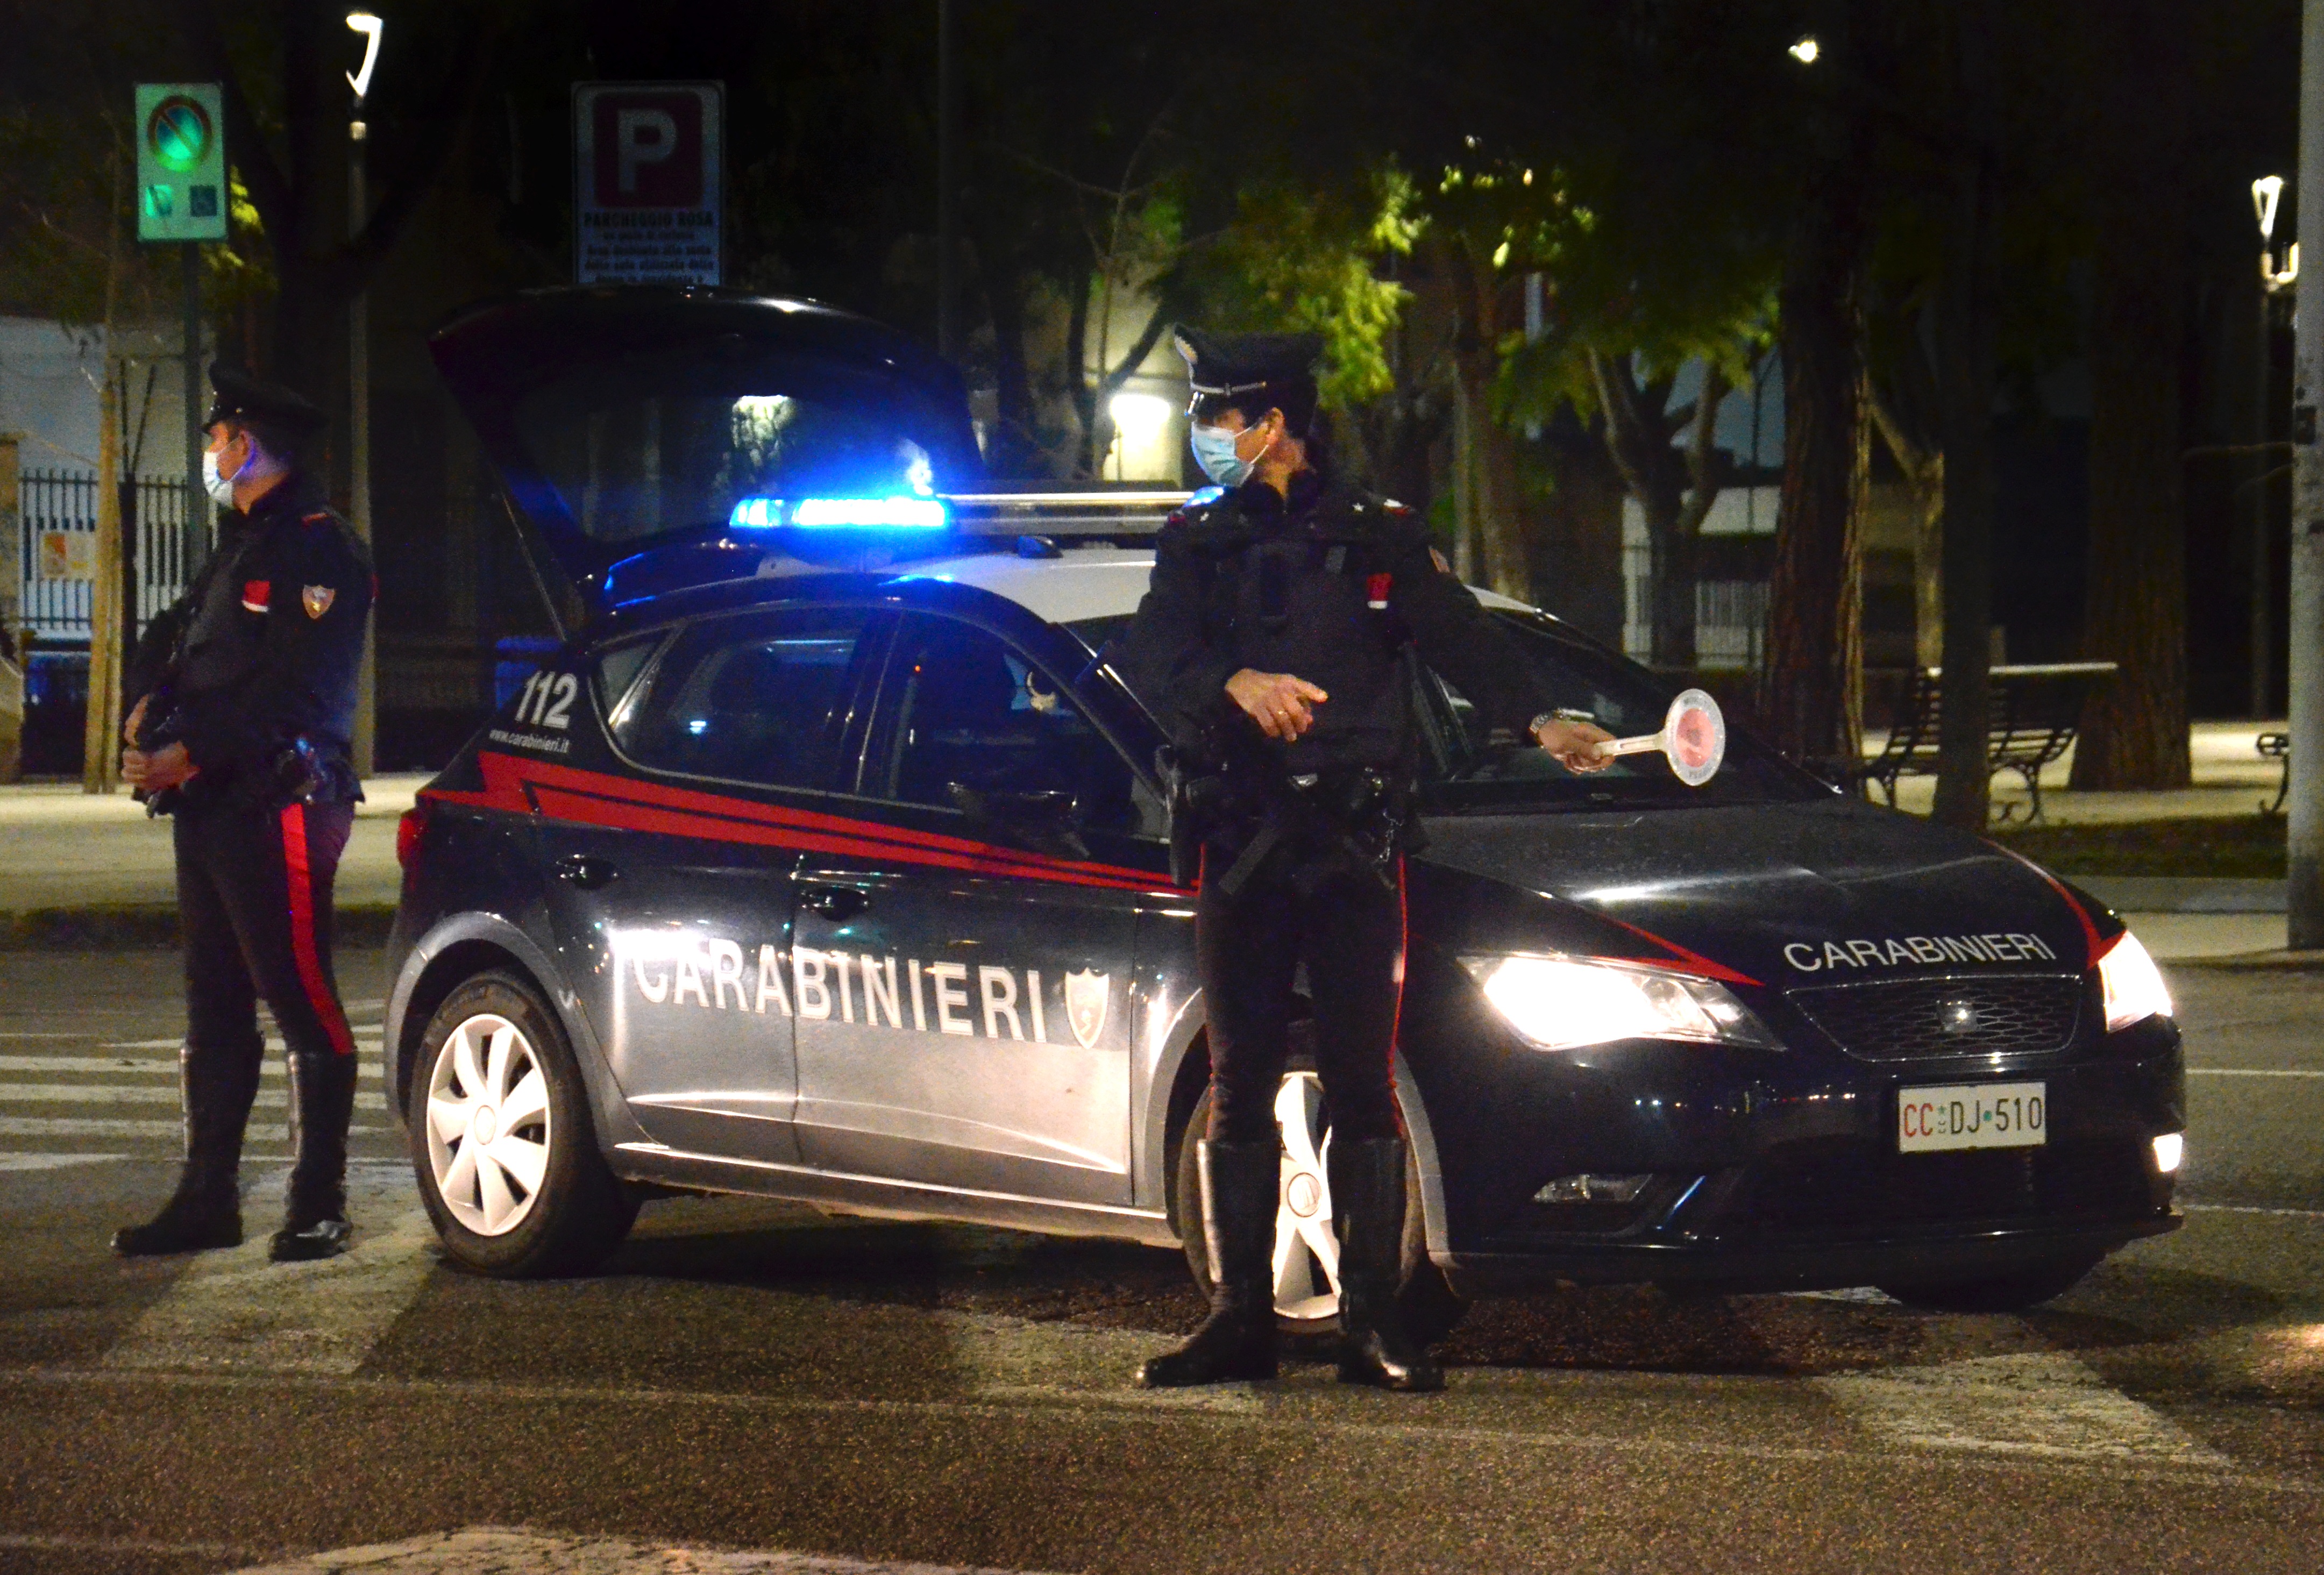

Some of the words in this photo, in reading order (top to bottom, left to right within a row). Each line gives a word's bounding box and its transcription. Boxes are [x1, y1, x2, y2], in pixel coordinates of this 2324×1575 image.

[617, 109, 677, 193] P
[515, 671, 577, 729] 112
[1783, 933, 2057, 972] CARABINIERI
[632, 936, 1047, 1043] CARABINIERI
[1903, 1103, 1934, 1137] CC
[1950, 1100, 1981, 1134] DJ
[1995, 1097, 2042, 1134] 510
